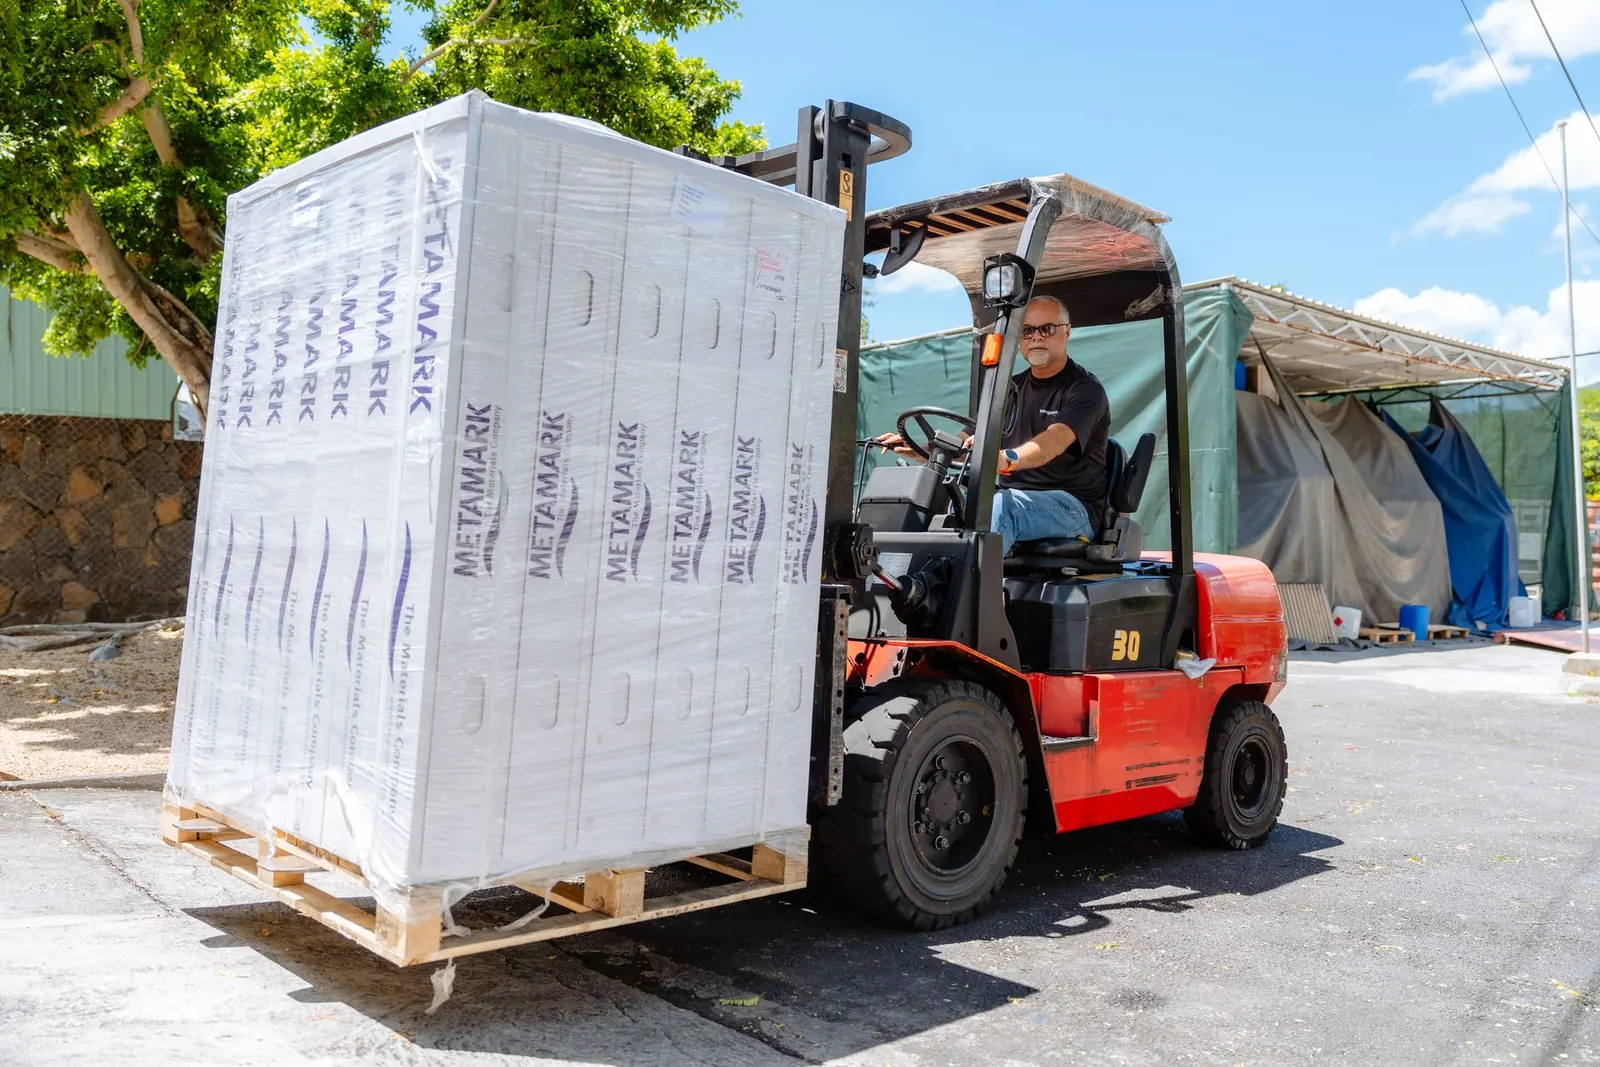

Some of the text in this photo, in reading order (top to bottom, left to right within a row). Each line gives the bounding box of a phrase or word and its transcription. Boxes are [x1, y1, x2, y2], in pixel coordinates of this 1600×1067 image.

[367, 171, 408, 418] TAMARK
[489, 404, 502, 449] Company
[562, 413, 575, 456] Cpany
[637, 423, 647, 464] Company
[485, 450, 497, 500] Materials
[528, 410, 565, 579] METAMARK
[558, 457, 570, 499] aterials
[606, 420, 639, 583] METAMARK
[670, 429, 700, 584] METAMARK
[726, 435, 755, 584] METAMARK
[322, 592, 332, 622] The
[358, 598, 370, 628] The
[402, 603, 415, 638] The
[313, 628, 328, 708] Materials
[1111, 629, 1140, 661] 30
[350, 635, 367, 719] Materials
[393, 643, 412, 731] Materials
[305, 713, 321, 790] Company
